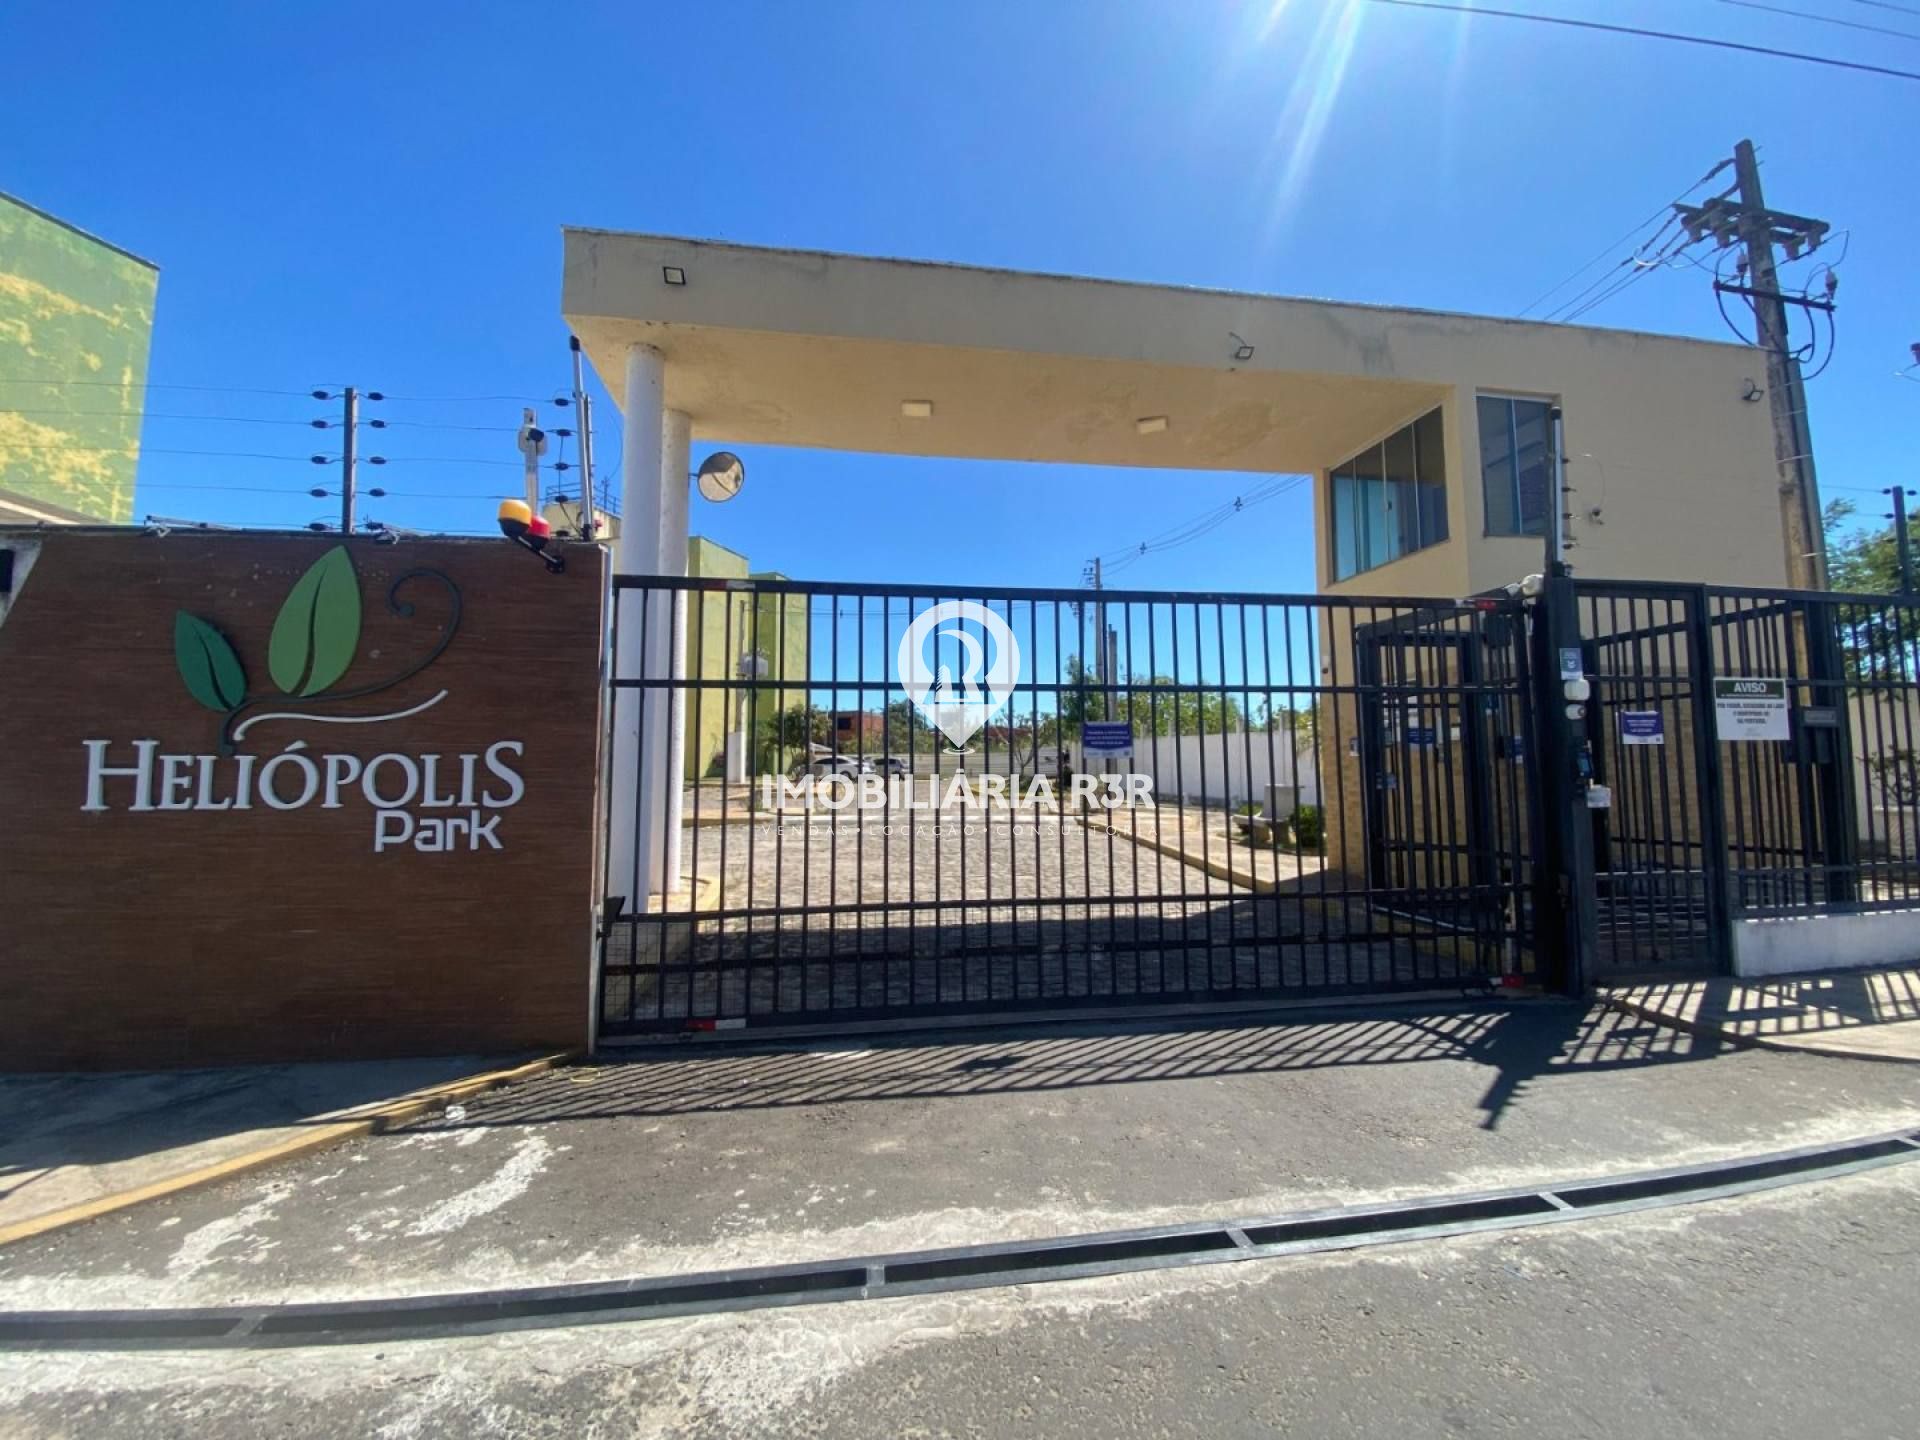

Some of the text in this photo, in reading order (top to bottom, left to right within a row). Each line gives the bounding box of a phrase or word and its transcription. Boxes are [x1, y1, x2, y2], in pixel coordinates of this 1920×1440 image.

[1733, 682, 1767, 693] AVISO
[80, 739, 525, 811] HELIÓPOLIS
[373, 808, 504, 853] Park
